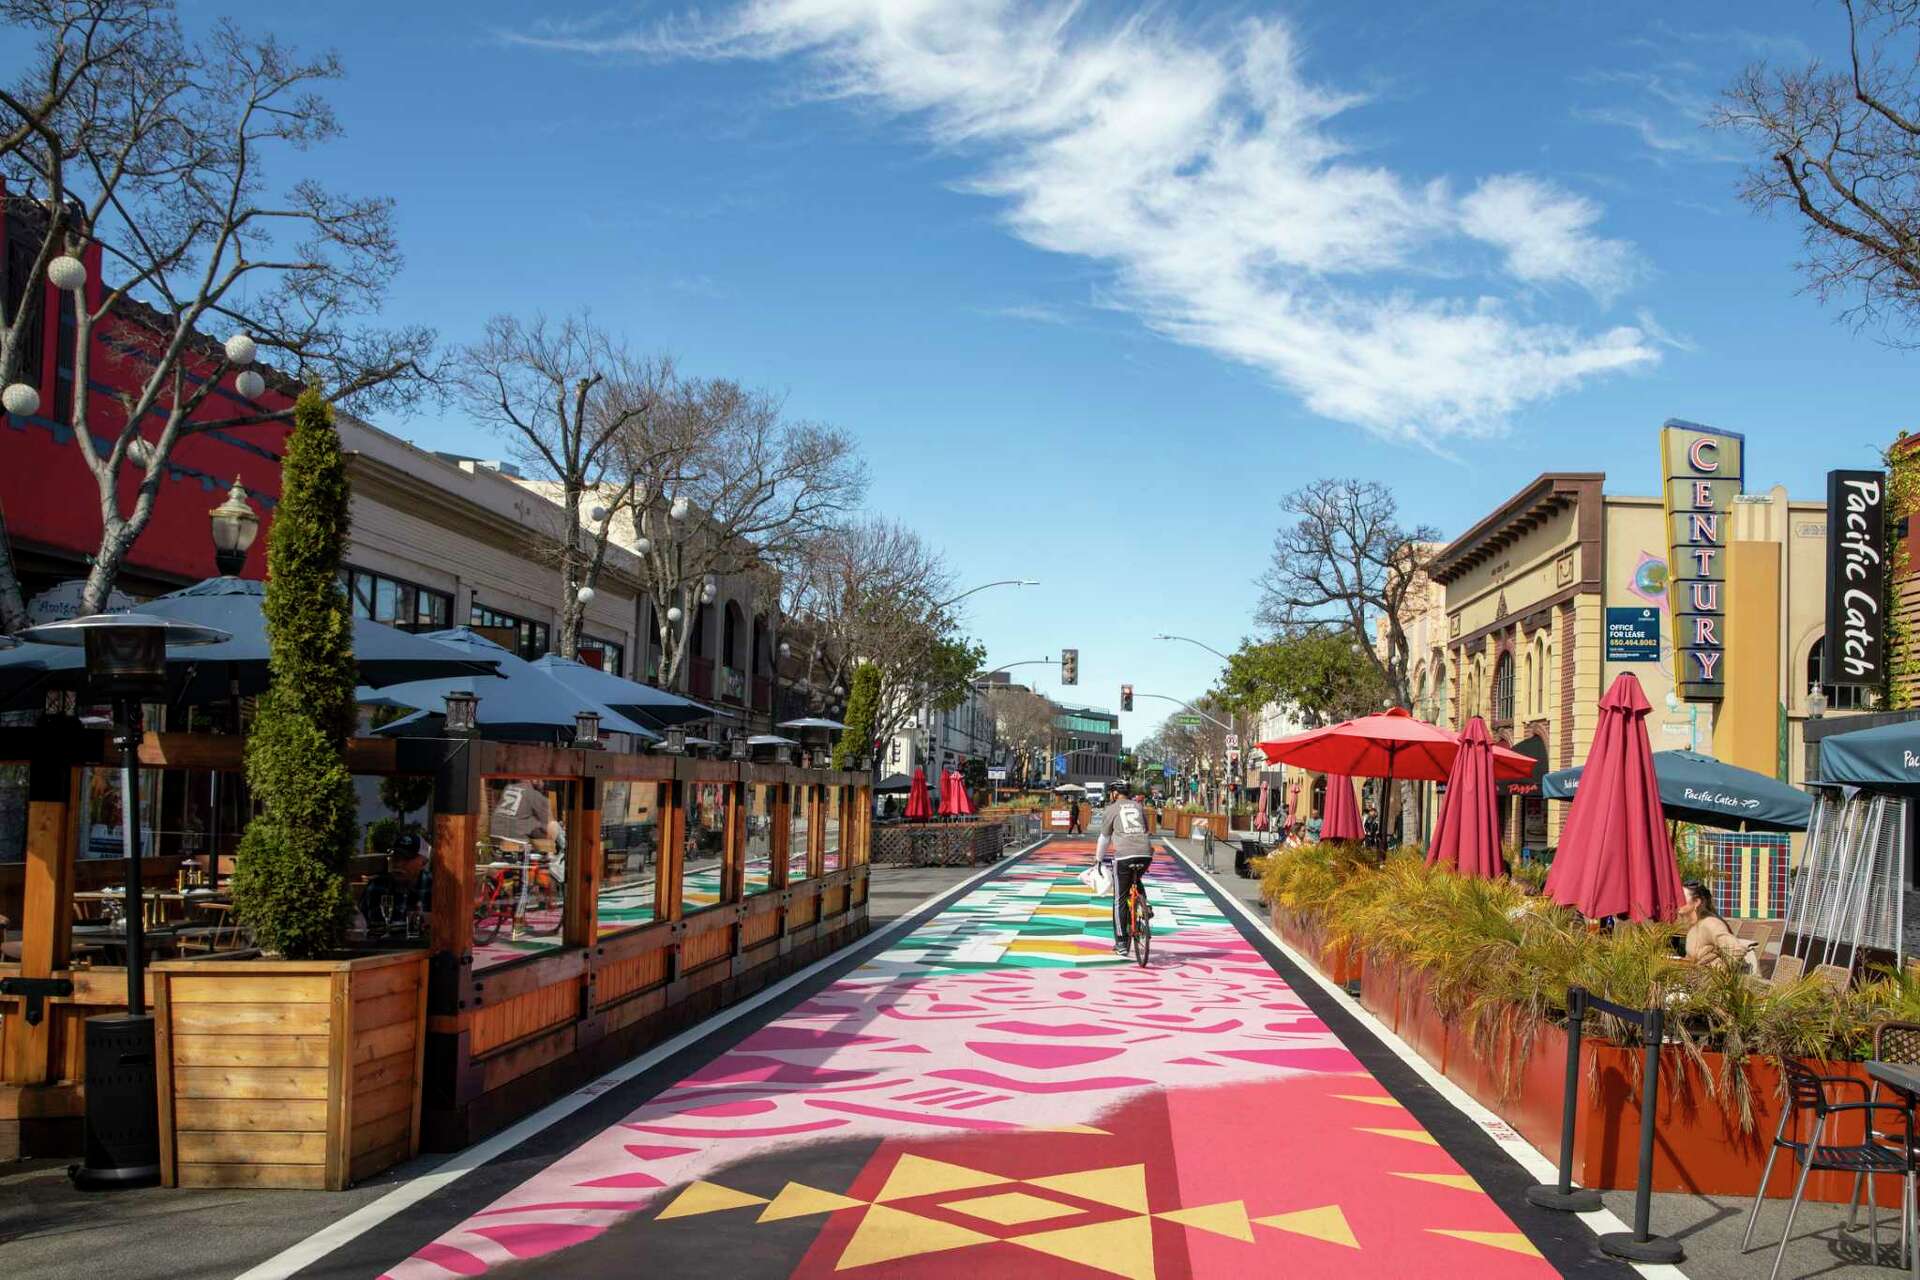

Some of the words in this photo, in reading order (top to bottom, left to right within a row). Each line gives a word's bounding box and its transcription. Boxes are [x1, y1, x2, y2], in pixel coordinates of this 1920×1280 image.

[1690, 438, 1720, 680] CENTURY
[1840, 480, 1880, 581] Pacific
[1843, 588, 1877, 676] Catch
[1684, 788, 1713, 802] Pacific
[1714, 793, 1738, 807] Catch
